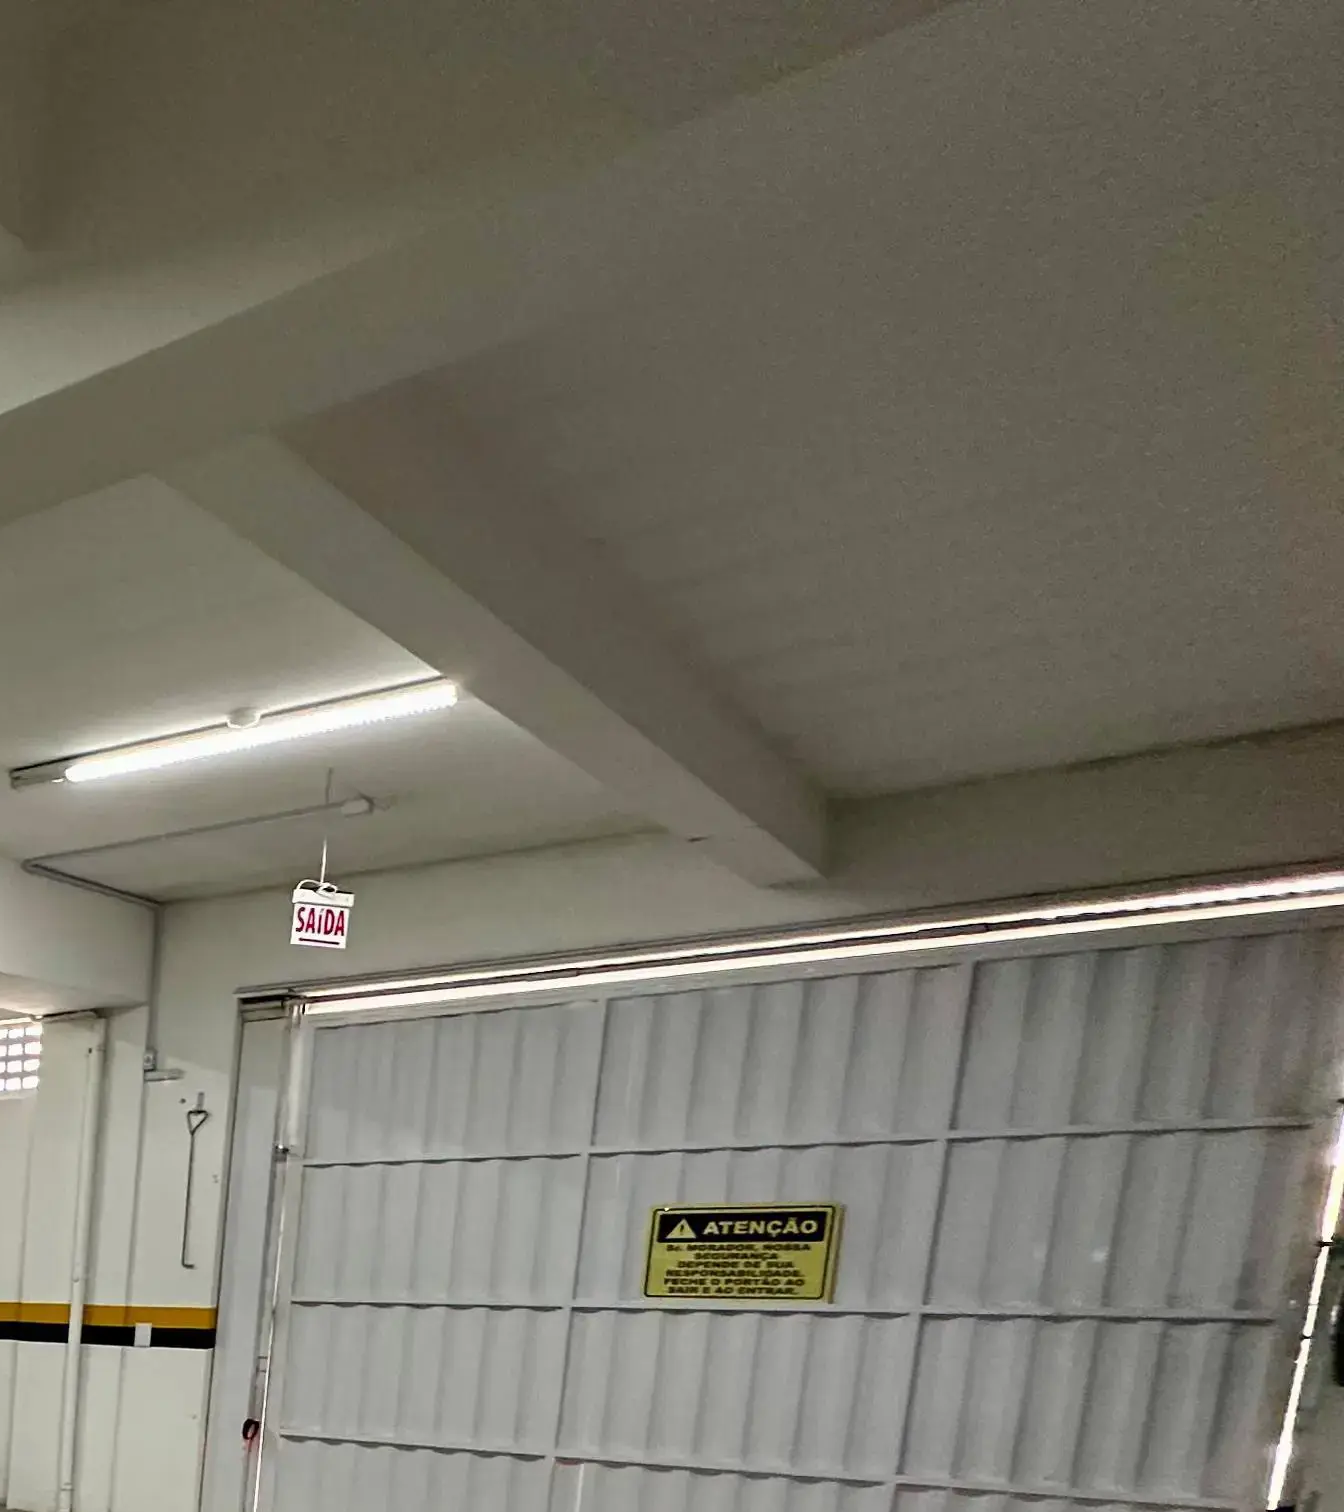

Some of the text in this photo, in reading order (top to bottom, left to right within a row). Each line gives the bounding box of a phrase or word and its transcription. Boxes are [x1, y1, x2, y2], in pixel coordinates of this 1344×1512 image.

[703, 1217, 819, 1238] ATENÇÃO
[694, 1252, 779, 1261] SEGURANÇA
[677, 1261, 741, 1269] DEPENDE
[743, 1261, 761, 1269] DE
[663, 1276, 806, 1287] FECHE O PORTÃO AO
[702, 1286, 711, 1294] E
